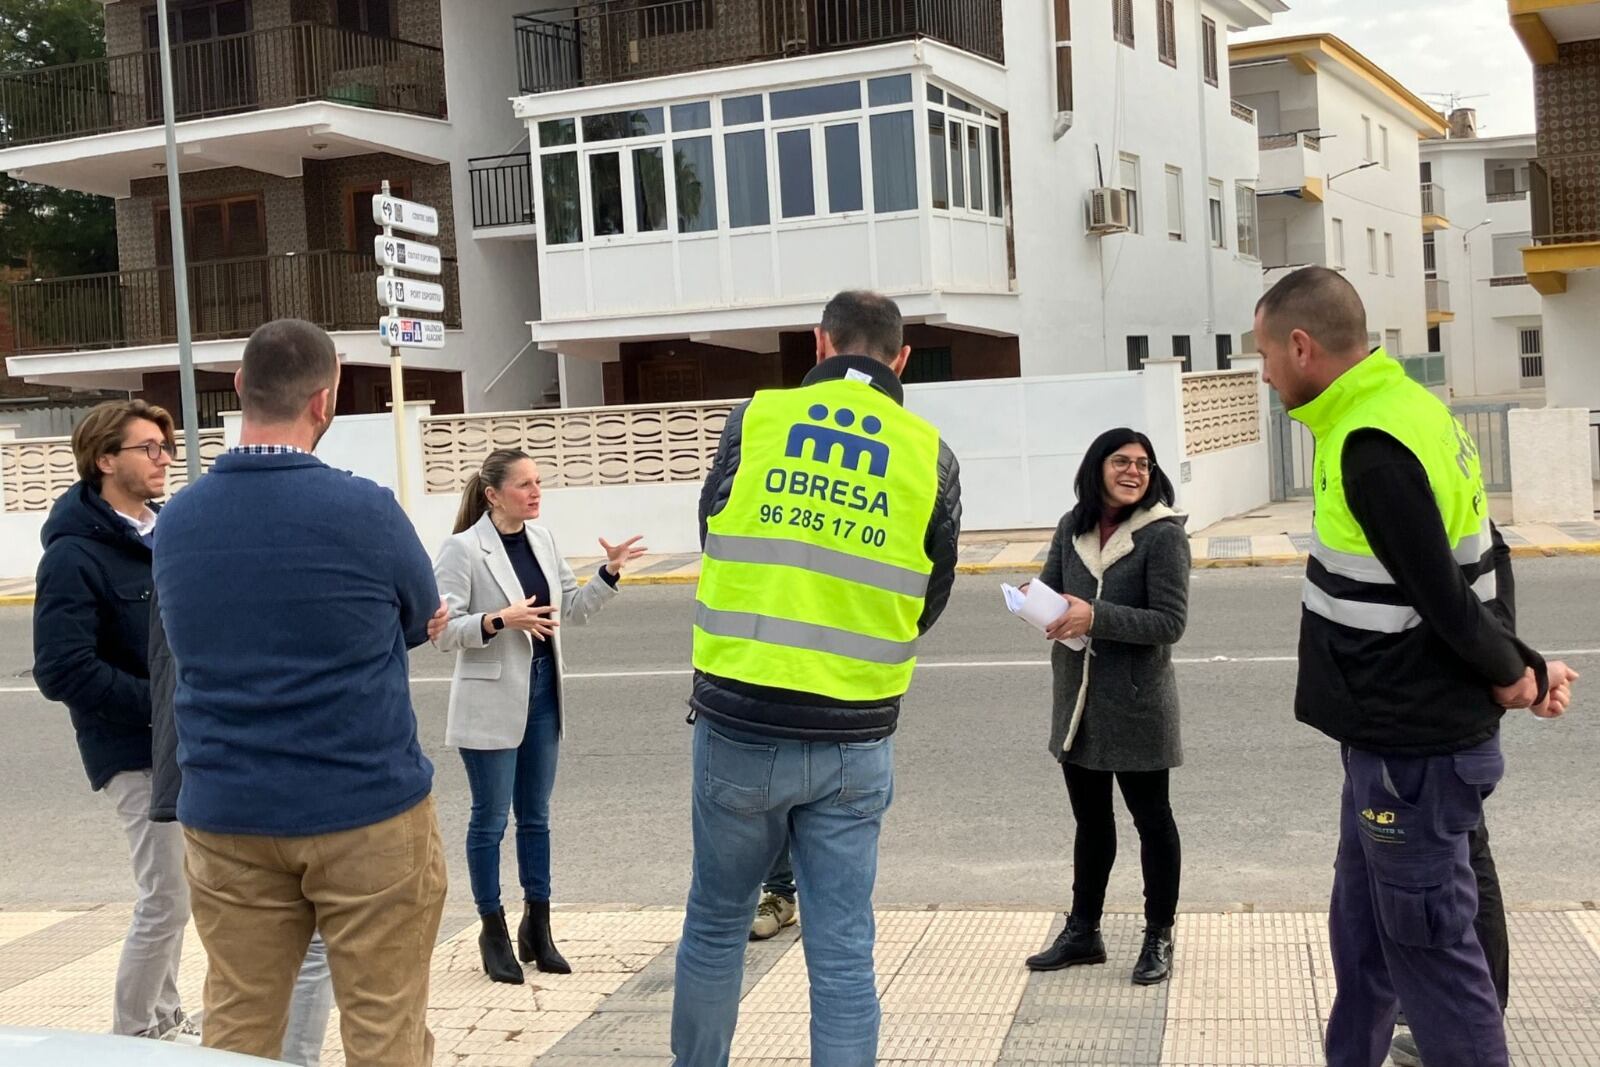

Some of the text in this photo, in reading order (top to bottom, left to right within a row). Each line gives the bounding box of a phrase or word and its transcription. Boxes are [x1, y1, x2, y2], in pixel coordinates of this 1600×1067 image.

[765, 468, 889, 517] OBRESA
[759, 504, 886, 547] 96 285 17 00
